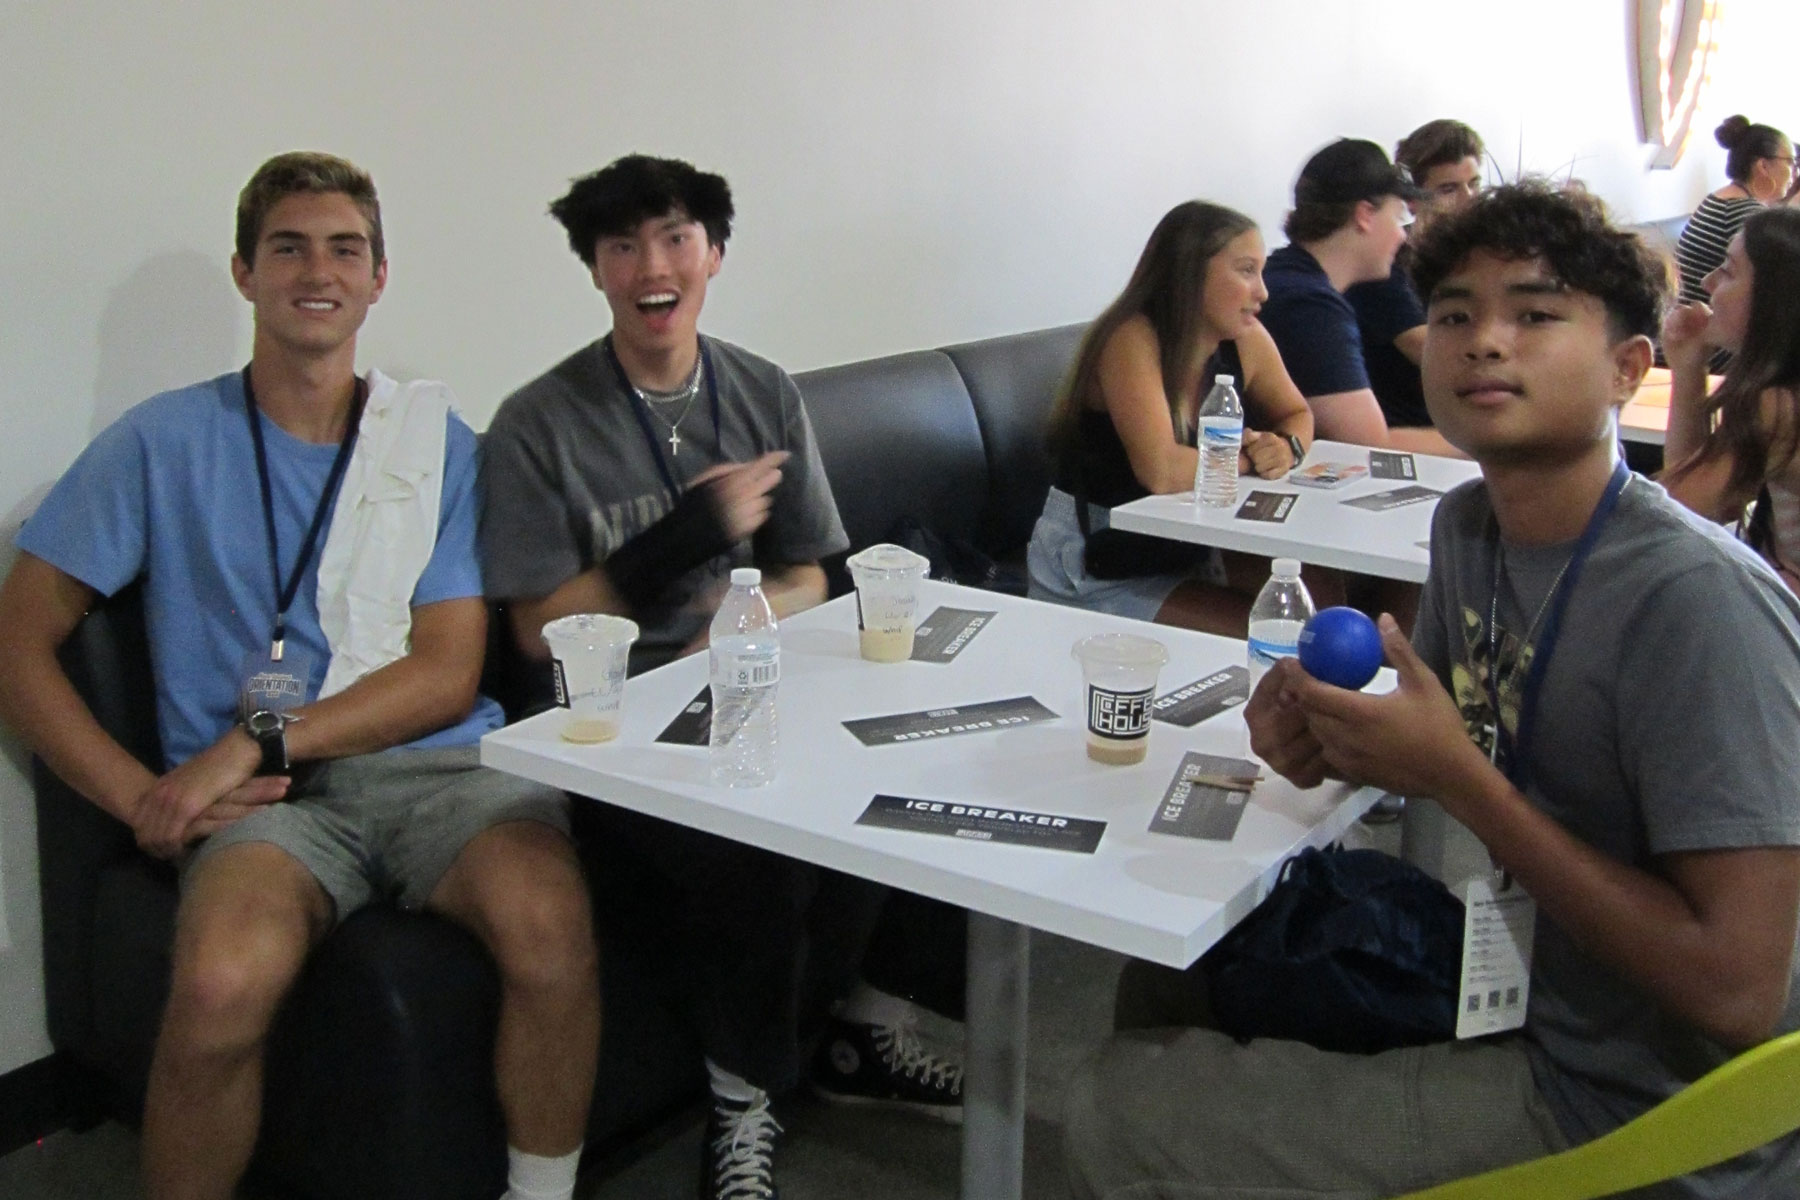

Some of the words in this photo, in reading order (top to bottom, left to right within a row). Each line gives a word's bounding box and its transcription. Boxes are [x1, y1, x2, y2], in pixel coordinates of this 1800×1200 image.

[249, 678, 300, 695] ORIENTATION
[1153, 698, 1178, 709] ICE
[1174, 672, 1232, 700] BREAKER
[996, 715, 1030, 726] ICE
[894, 721, 993, 740] BREAKER
[905, 800, 945, 812] ICE
[950, 804, 1068, 828] BREAKER
[1161, 804, 1183, 822] ICE
